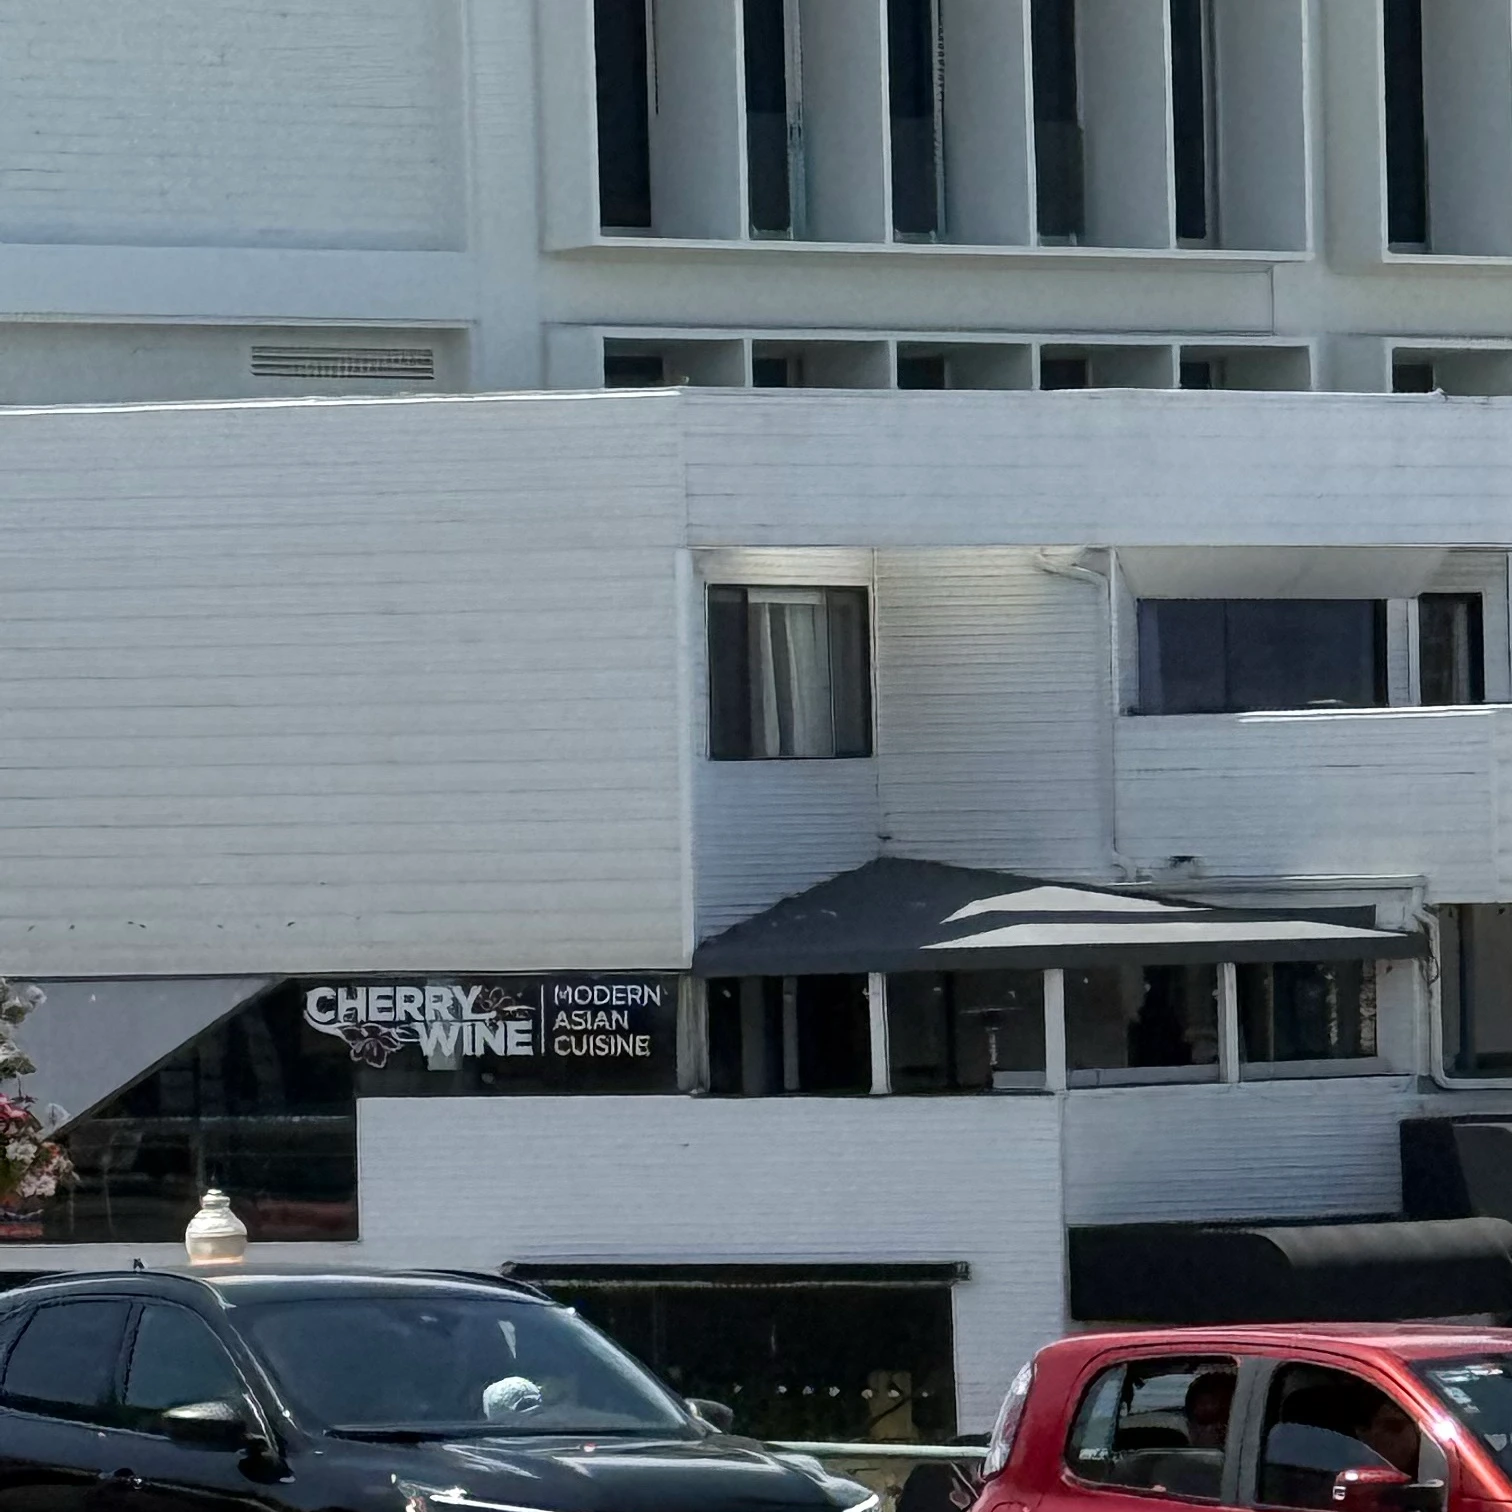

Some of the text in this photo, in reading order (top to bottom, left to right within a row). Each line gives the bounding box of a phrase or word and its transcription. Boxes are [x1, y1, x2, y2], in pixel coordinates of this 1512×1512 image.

[304, 985, 497, 1023] CHERRY
[552, 984, 662, 1006] MODERN
[552, 1010, 630, 1031] ASIAN
[416, 1020, 535, 1058] WINE
[552, 1034, 652, 1058] CUISINE
